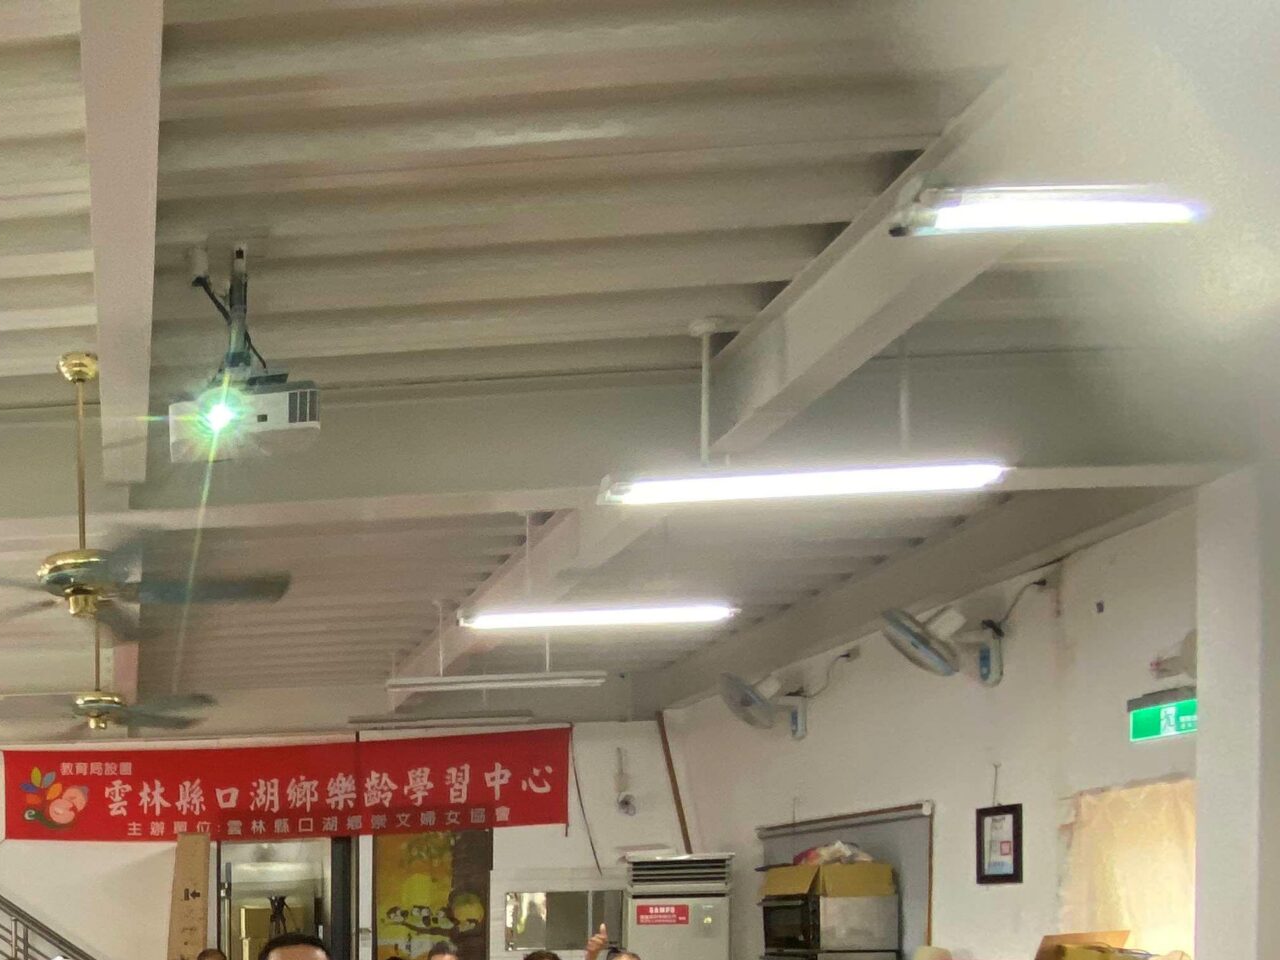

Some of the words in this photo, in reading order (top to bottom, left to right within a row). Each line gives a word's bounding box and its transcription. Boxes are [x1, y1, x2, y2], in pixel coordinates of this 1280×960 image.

[104, 762, 553, 818] 雲林縣口湖鄉樂齡學習中心
